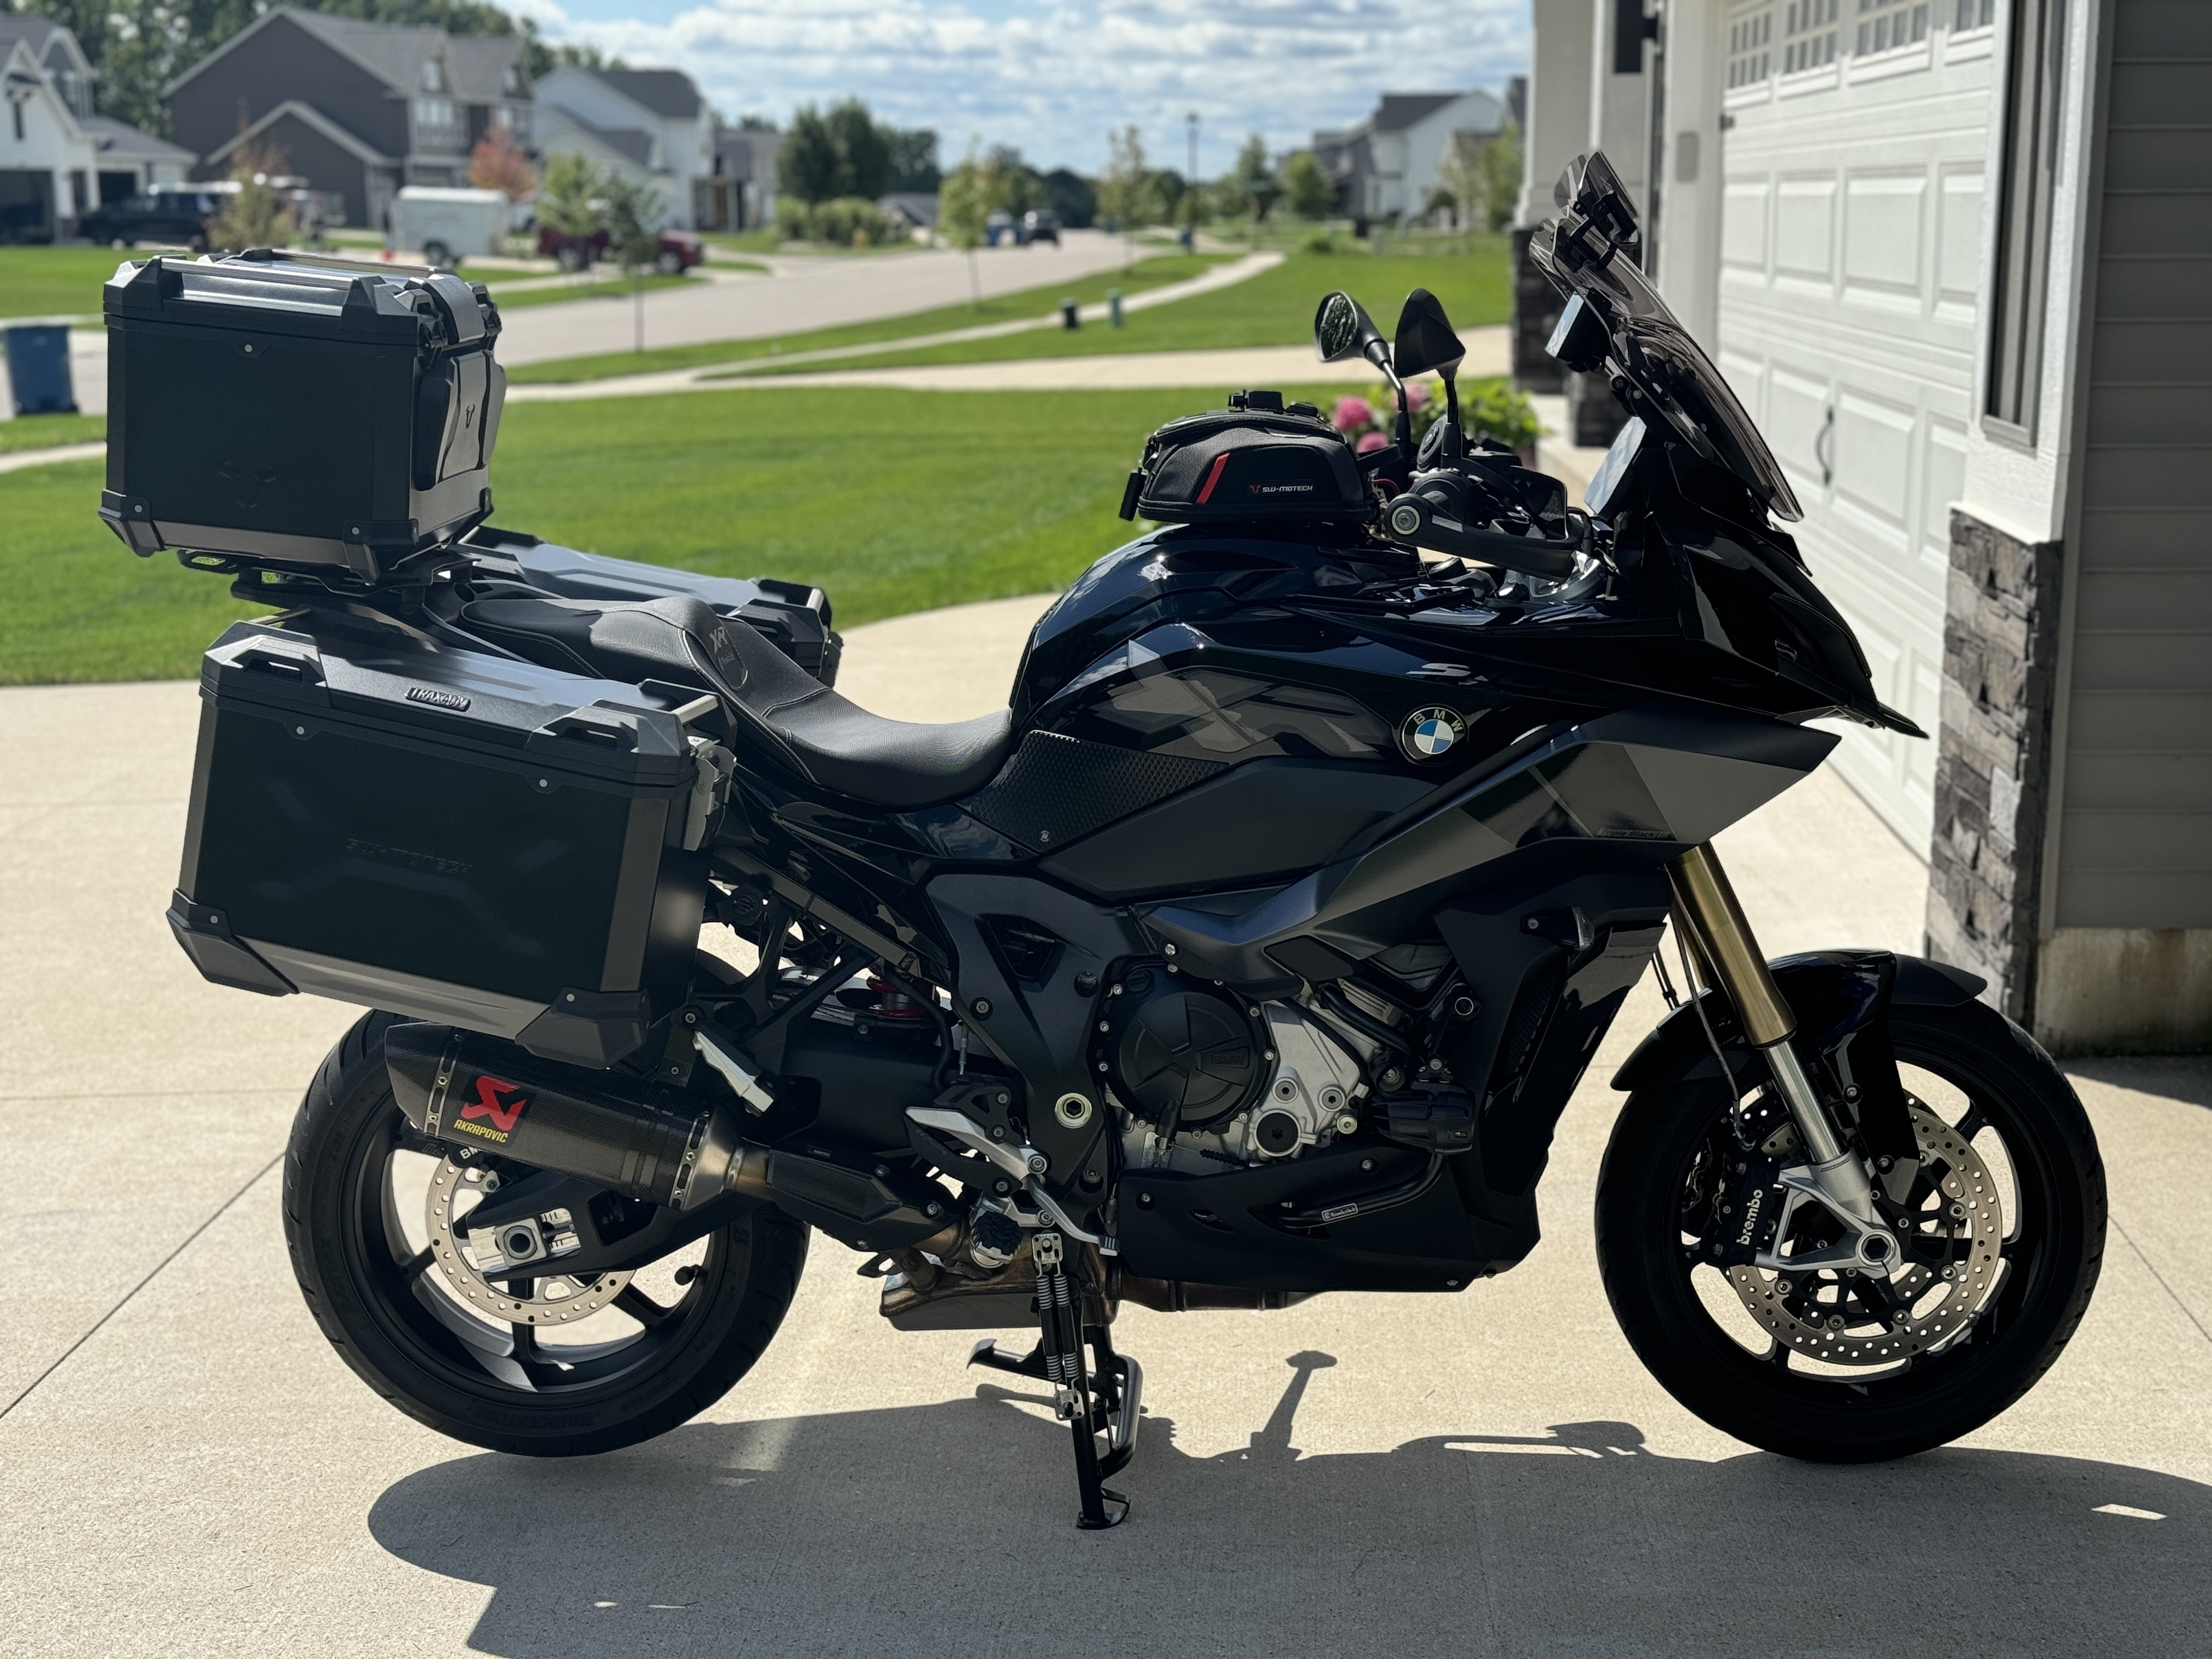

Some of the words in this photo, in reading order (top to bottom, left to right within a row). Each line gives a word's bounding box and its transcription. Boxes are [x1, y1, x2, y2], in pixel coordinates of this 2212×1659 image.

[1261, 485, 1314, 493] SW-MOTECH
[709, 627, 729, 654] XR
[1413, 709, 1464, 732] BMW
[453, 1119, 509, 1143] AKRAPOVIC
[460, 1146, 481, 1160] BM
[1736, 1189, 1763, 1245] brembo
